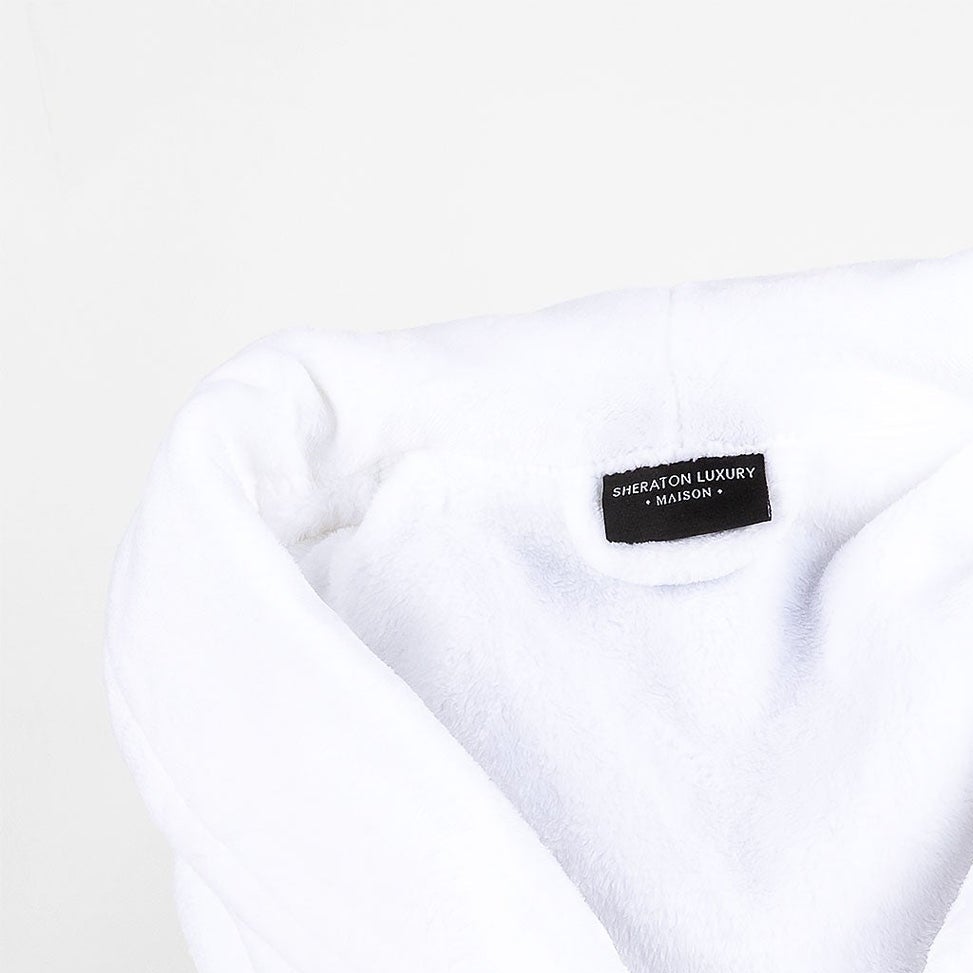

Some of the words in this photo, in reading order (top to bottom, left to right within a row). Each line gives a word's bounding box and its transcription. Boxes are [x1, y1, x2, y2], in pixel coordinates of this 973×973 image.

[612, 472, 692, 498] SHERATON
[697, 467, 756, 483] LUXURY
[656, 487, 712, 506] MAISON
